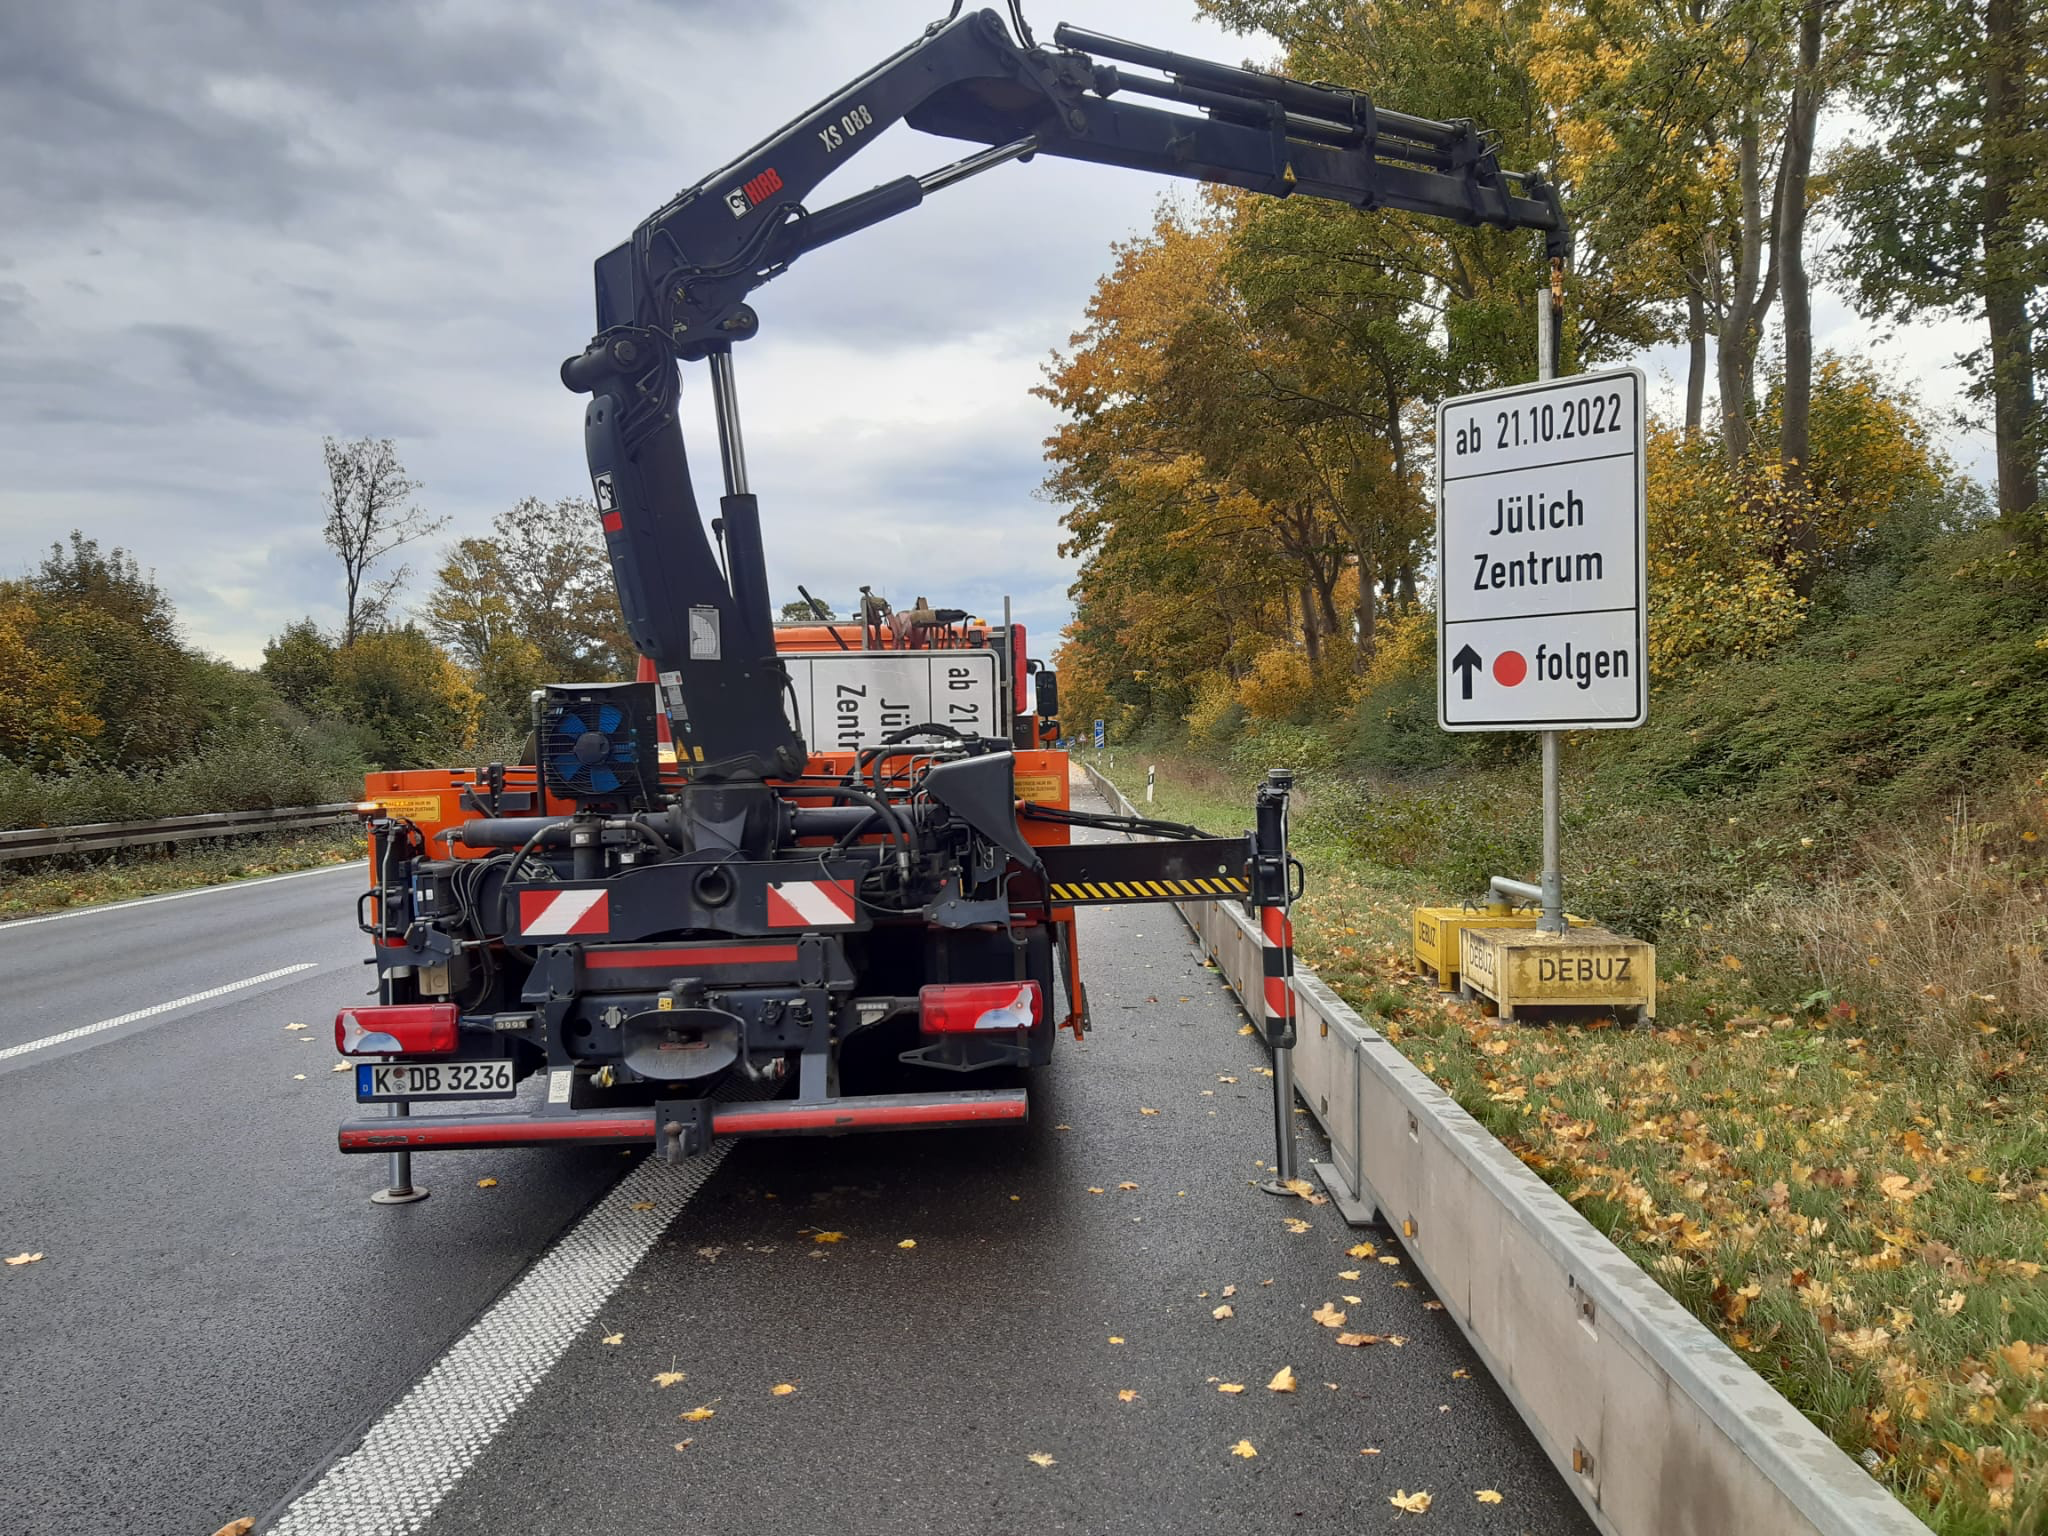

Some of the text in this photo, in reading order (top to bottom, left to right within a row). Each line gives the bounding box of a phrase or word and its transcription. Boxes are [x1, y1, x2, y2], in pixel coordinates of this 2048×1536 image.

[818, 104, 873, 153] XS 088
[743, 167, 784, 206] HIAB
[1456, 393, 1621, 456] ab 21.10.2022
[1489, 489, 1584, 536] Jülich
[1473, 551, 1603, 591] Zentrum
[948, 668, 978, 690] ab
[1535, 642, 1629, 689] folgen
[1418, 920, 1436, 947] DEBUZ
[1470, 942, 1493, 975] DEBUZ
[1539, 957, 1632, 982] DEBUZ
[375, 1068, 391, 1093] K
[409, 1066, 441, 1092] DB
[447, 1065, 510, 1091] 3236
